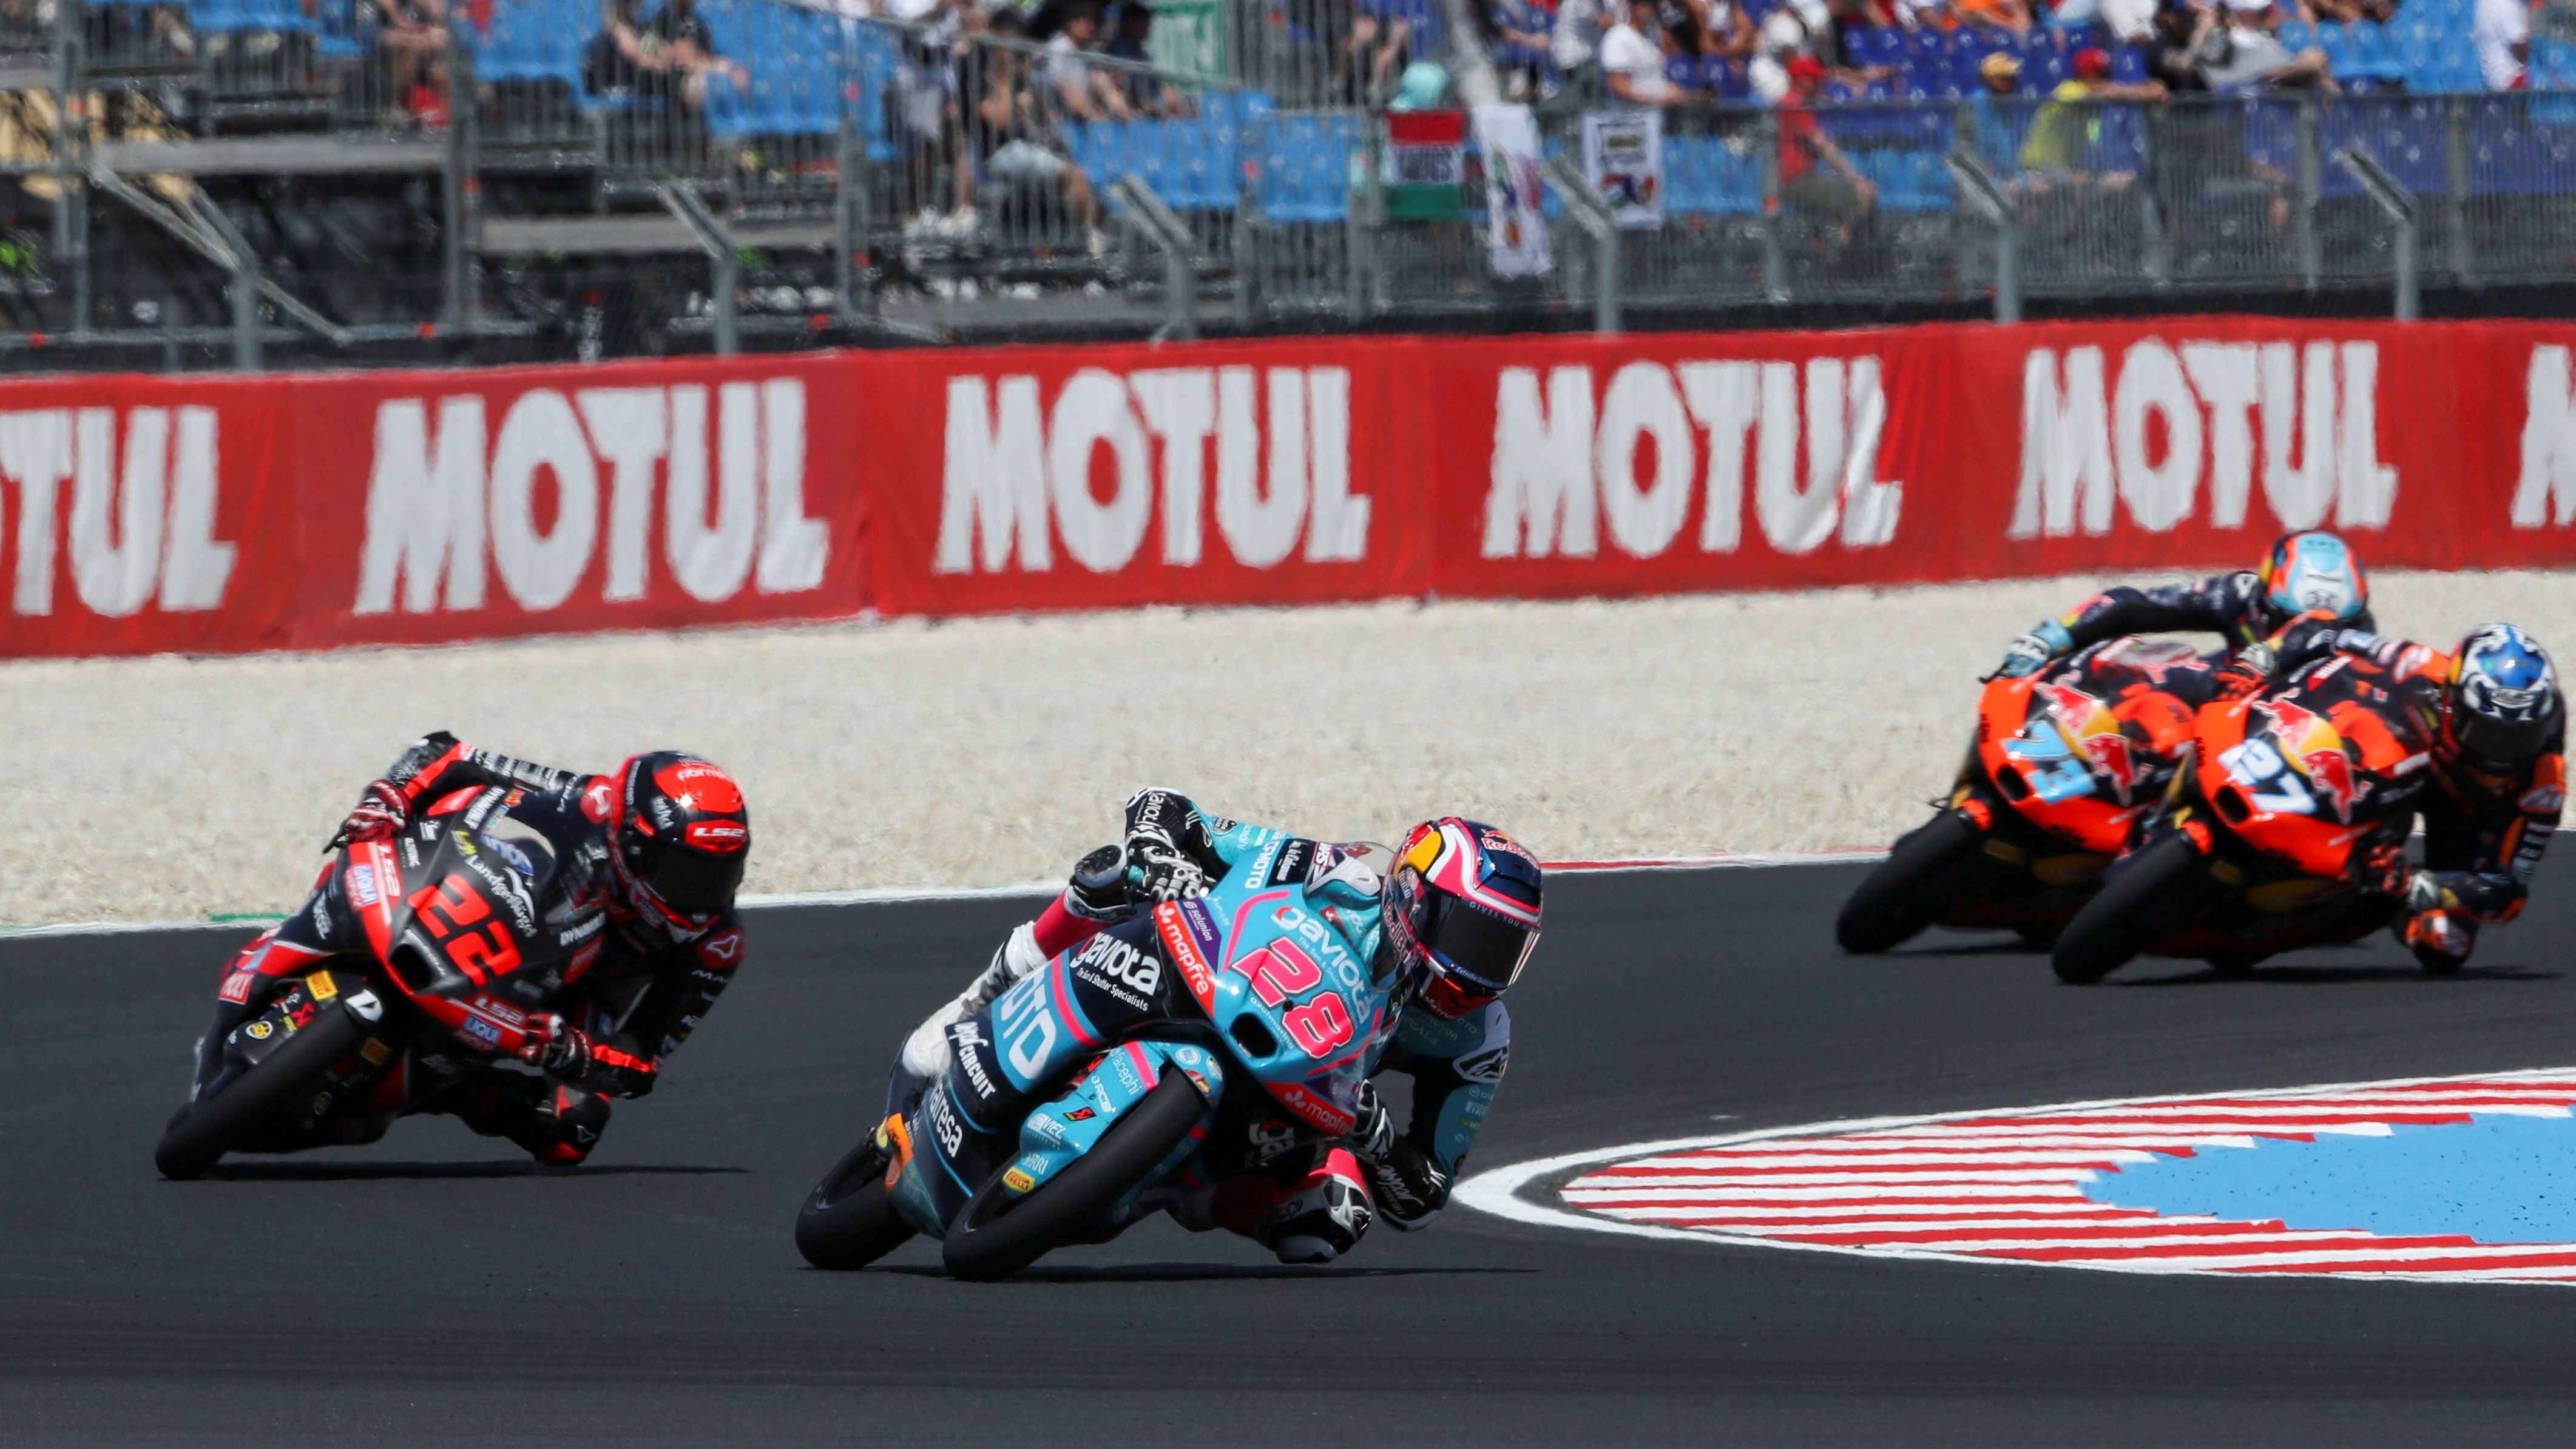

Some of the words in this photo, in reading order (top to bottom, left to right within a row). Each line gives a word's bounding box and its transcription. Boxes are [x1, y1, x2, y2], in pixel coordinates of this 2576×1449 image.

[933, 364, 1372, 575] MOTUL
[1480, 353, 1904, 559] MOTUL
[2006, 334, 2399, 538] MOTUL
[0, 407, 237, 617] TUL
[353, 377, 830, 612] MOTUL
[2218, 738, 2317, 813] 27
[694, 827, 745, 837] LS2
[407, 874, 522, 987] 22
[1191, 910, 1212, 941] solunion
[1298, 936, 1310, 950] The
[1310, 948, 1322, 962] Sun
[1469, 901, 1499, 918] GIVES
[1503, 915, 1520, 927] YOU
[1070, 931, 1160, 996] gaviota
[1092, 974, 1112, 991] Shutter
[1110, 984, 1149, 1012] Specialists
[1166, 924, 1209, 995] mapfre
[1271, 906, 1372, 1024] gaviota
[1000, 967, 1056, 1080] OTO
[1231, 936, 1353, 1059] 28
[958, 1044, 996, 1099] CIRCUIT
[1112, 1050, 1142, 1095] facephi
